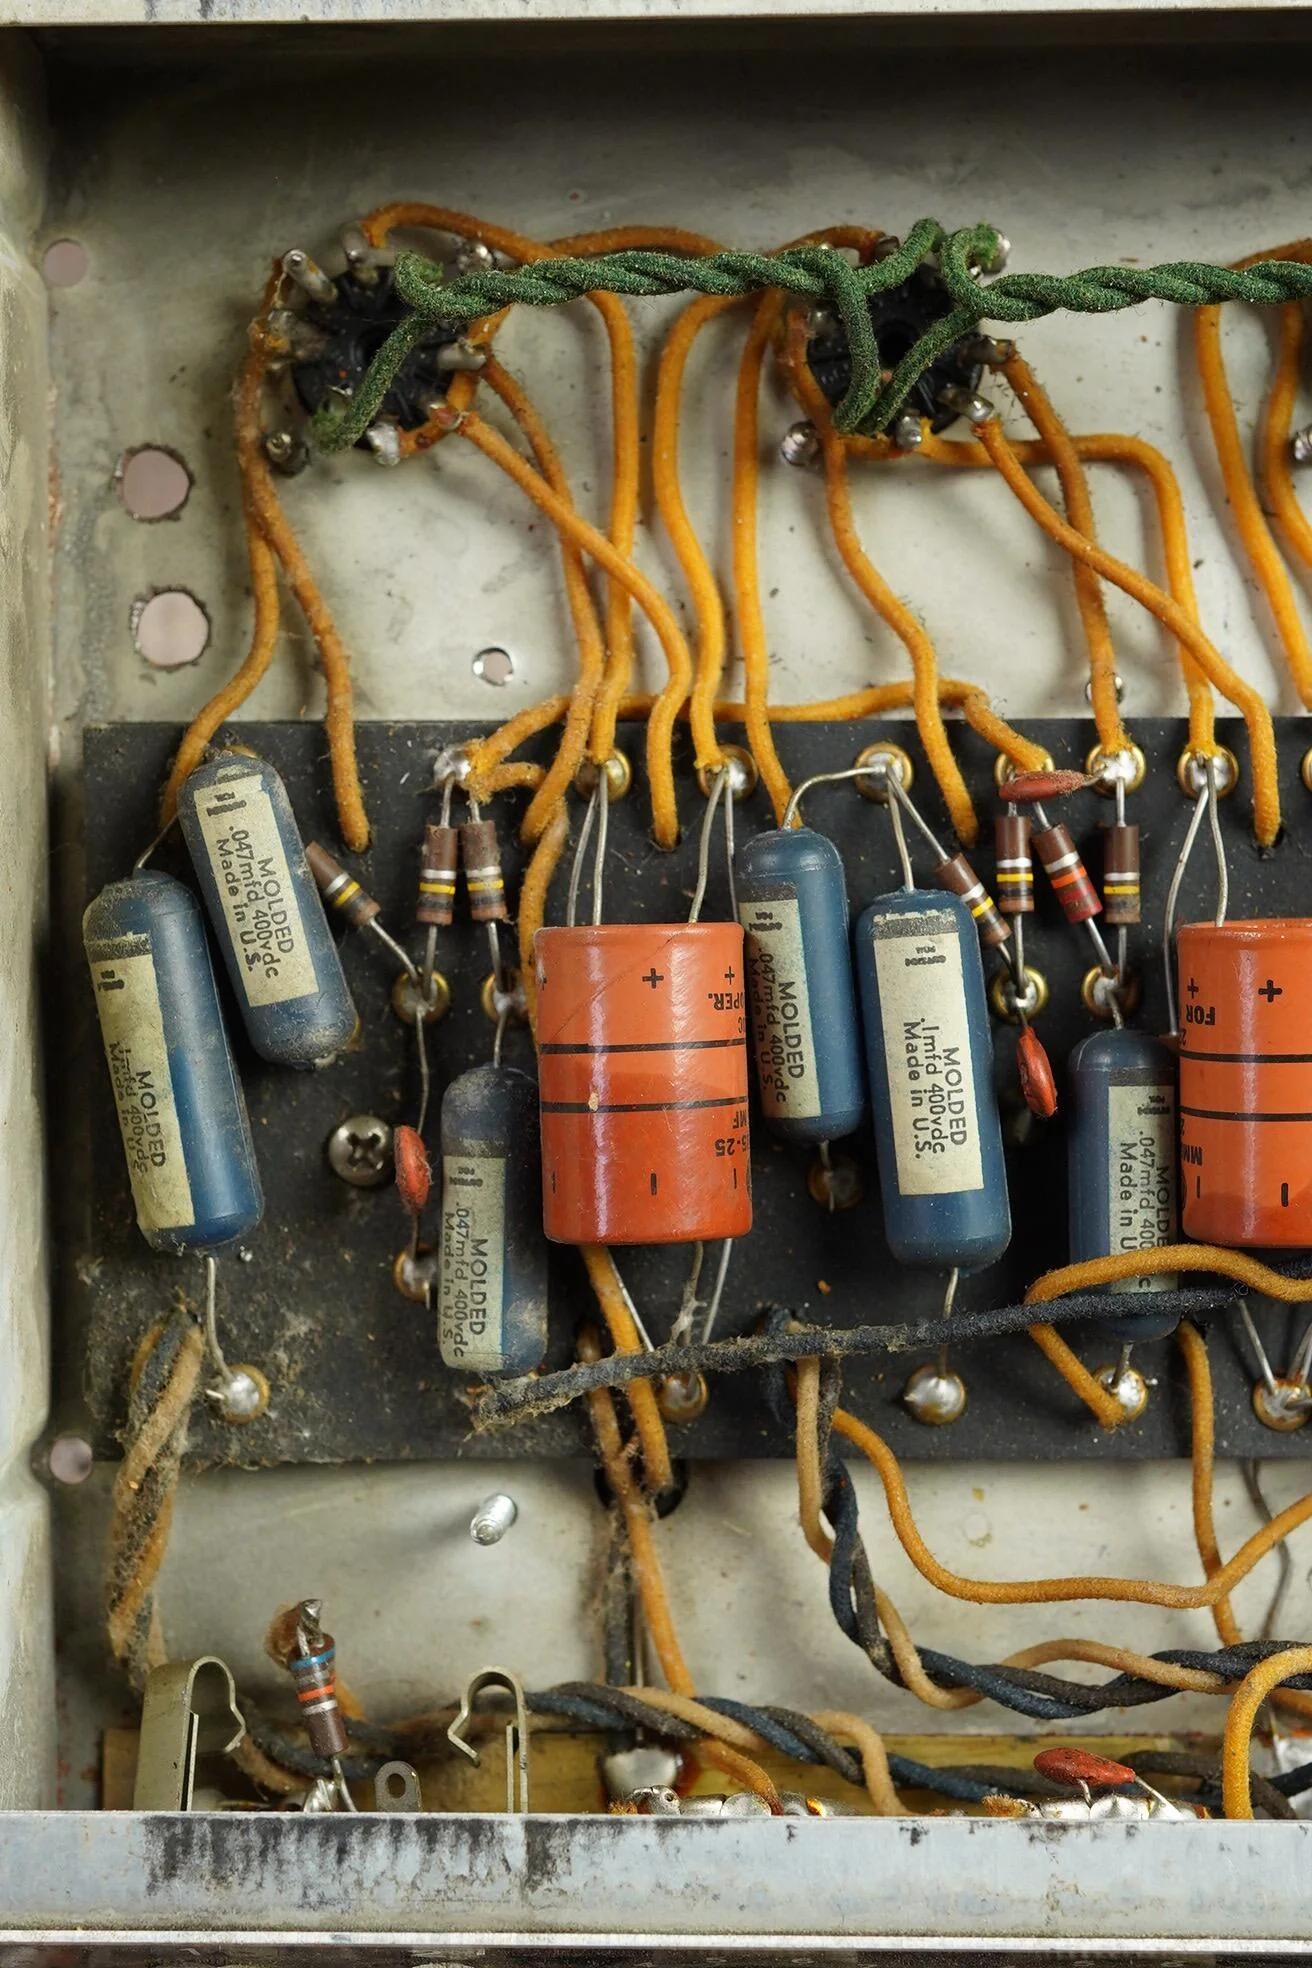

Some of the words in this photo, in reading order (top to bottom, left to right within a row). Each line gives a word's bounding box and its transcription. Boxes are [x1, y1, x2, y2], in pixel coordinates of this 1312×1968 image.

[216, 839, 240, 896] Made
[233, 903, 249, 922] in
[229, 826, 266, 901] .047mfd
[251, 909, 281, 979] 400vdc
[257, 857, 294, 954] MOLDED
[748, 958, 763, 1009] Made
[757, 1024, 767, 1042] in
[758, 948, 777, 1025] .047mfd
[770, 1035, 789, 1103] 400vdc
[778, 982, 805, 1078] MOLDED
[1186, 1004, 1216, 1026] FOR
[903, 1022, 922, 1080] Made
[135, 1070, 167, 1167] MOLDED
[910, 1089, 927, 1107] in
[925, 1083, 948, 1154] 400vdc
[942, 1047, 967, 1146] MOLDED
[1120, 1143, 1137, 1200] Made
[1139, 1131, 1155, 1209] .047mfd
[1156, 1166, 1169, 1246] MOLDE
[443, 1212, 454, 1270] Made
[454, 1203, 470, 1280] .047mfd
[1120, 1209, 1137, 1227] in
[443, 1279, 454, 1296] in
[453, 1289, 469, 1357] 400vdc
[470, 1239, 488, 1335] MOLDED
